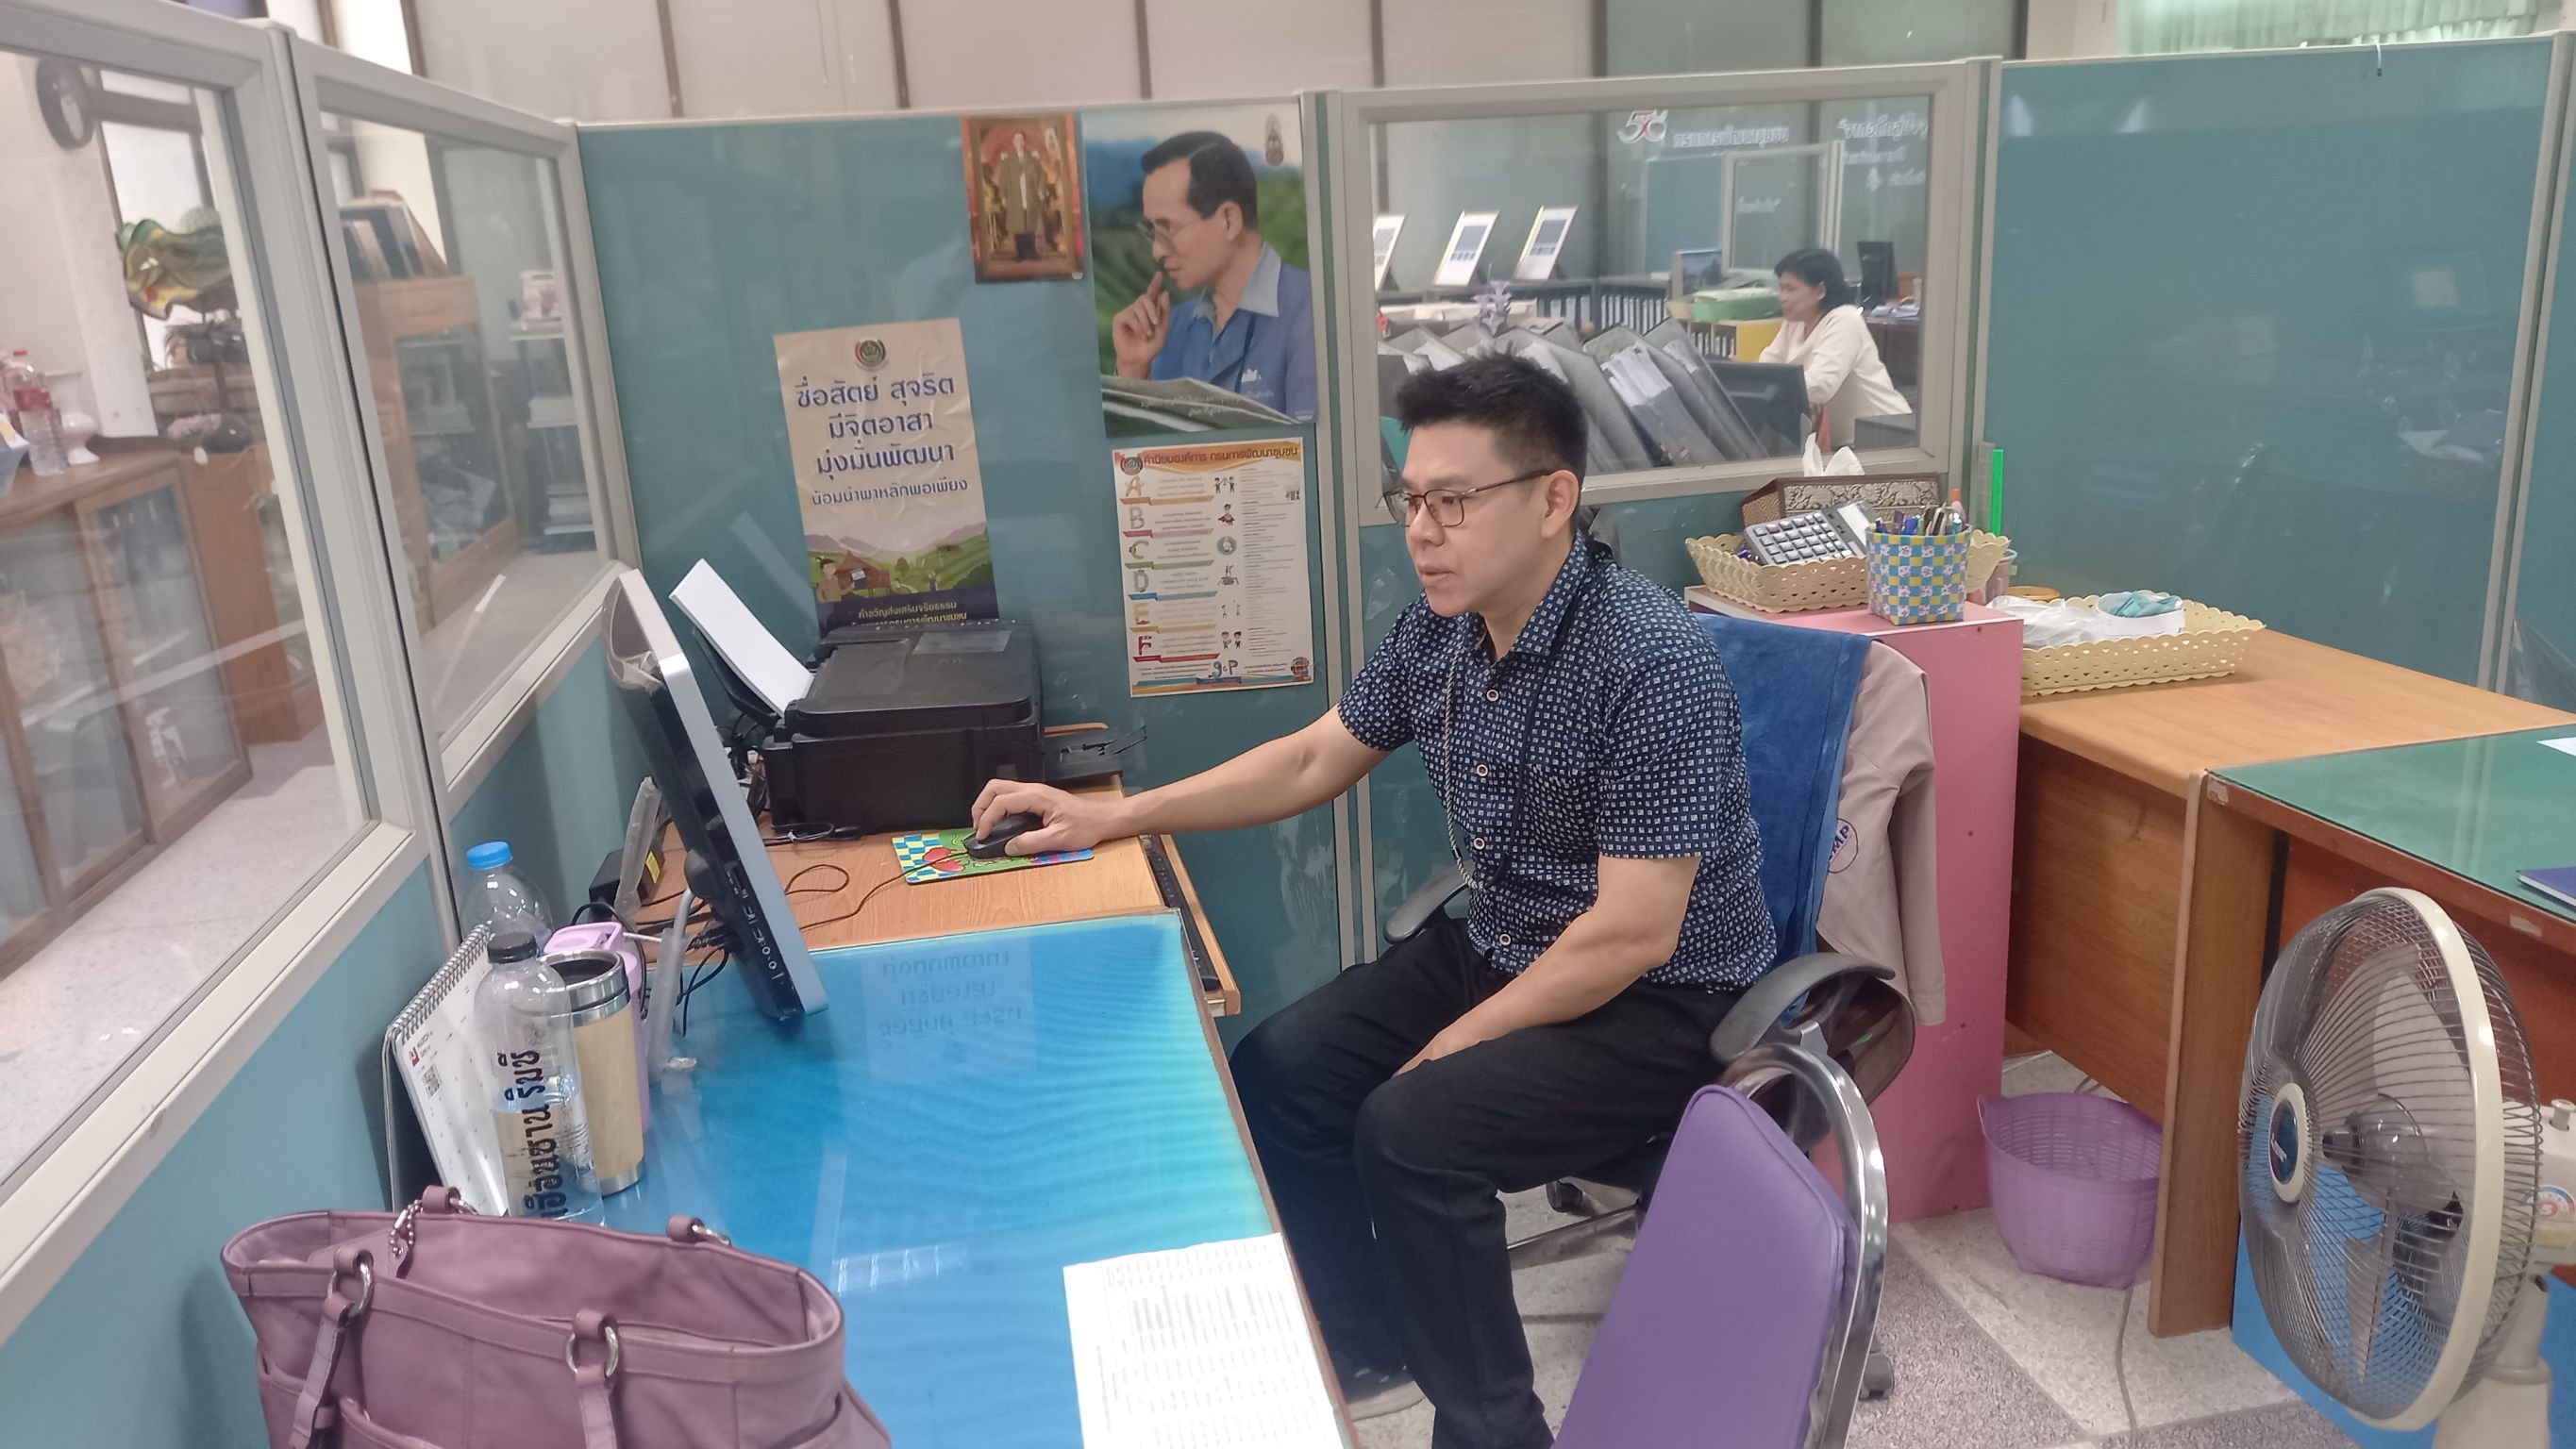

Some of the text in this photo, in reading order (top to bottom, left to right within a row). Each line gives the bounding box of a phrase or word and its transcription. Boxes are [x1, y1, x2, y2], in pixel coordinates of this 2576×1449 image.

[795, 372, 955, 408] ซื่อสัตย์ สุจริต
[828, 411, 933, 439] มีจิตอาสา
[816, 438, 955, 479] มุ่งมั่นพัฒนา
